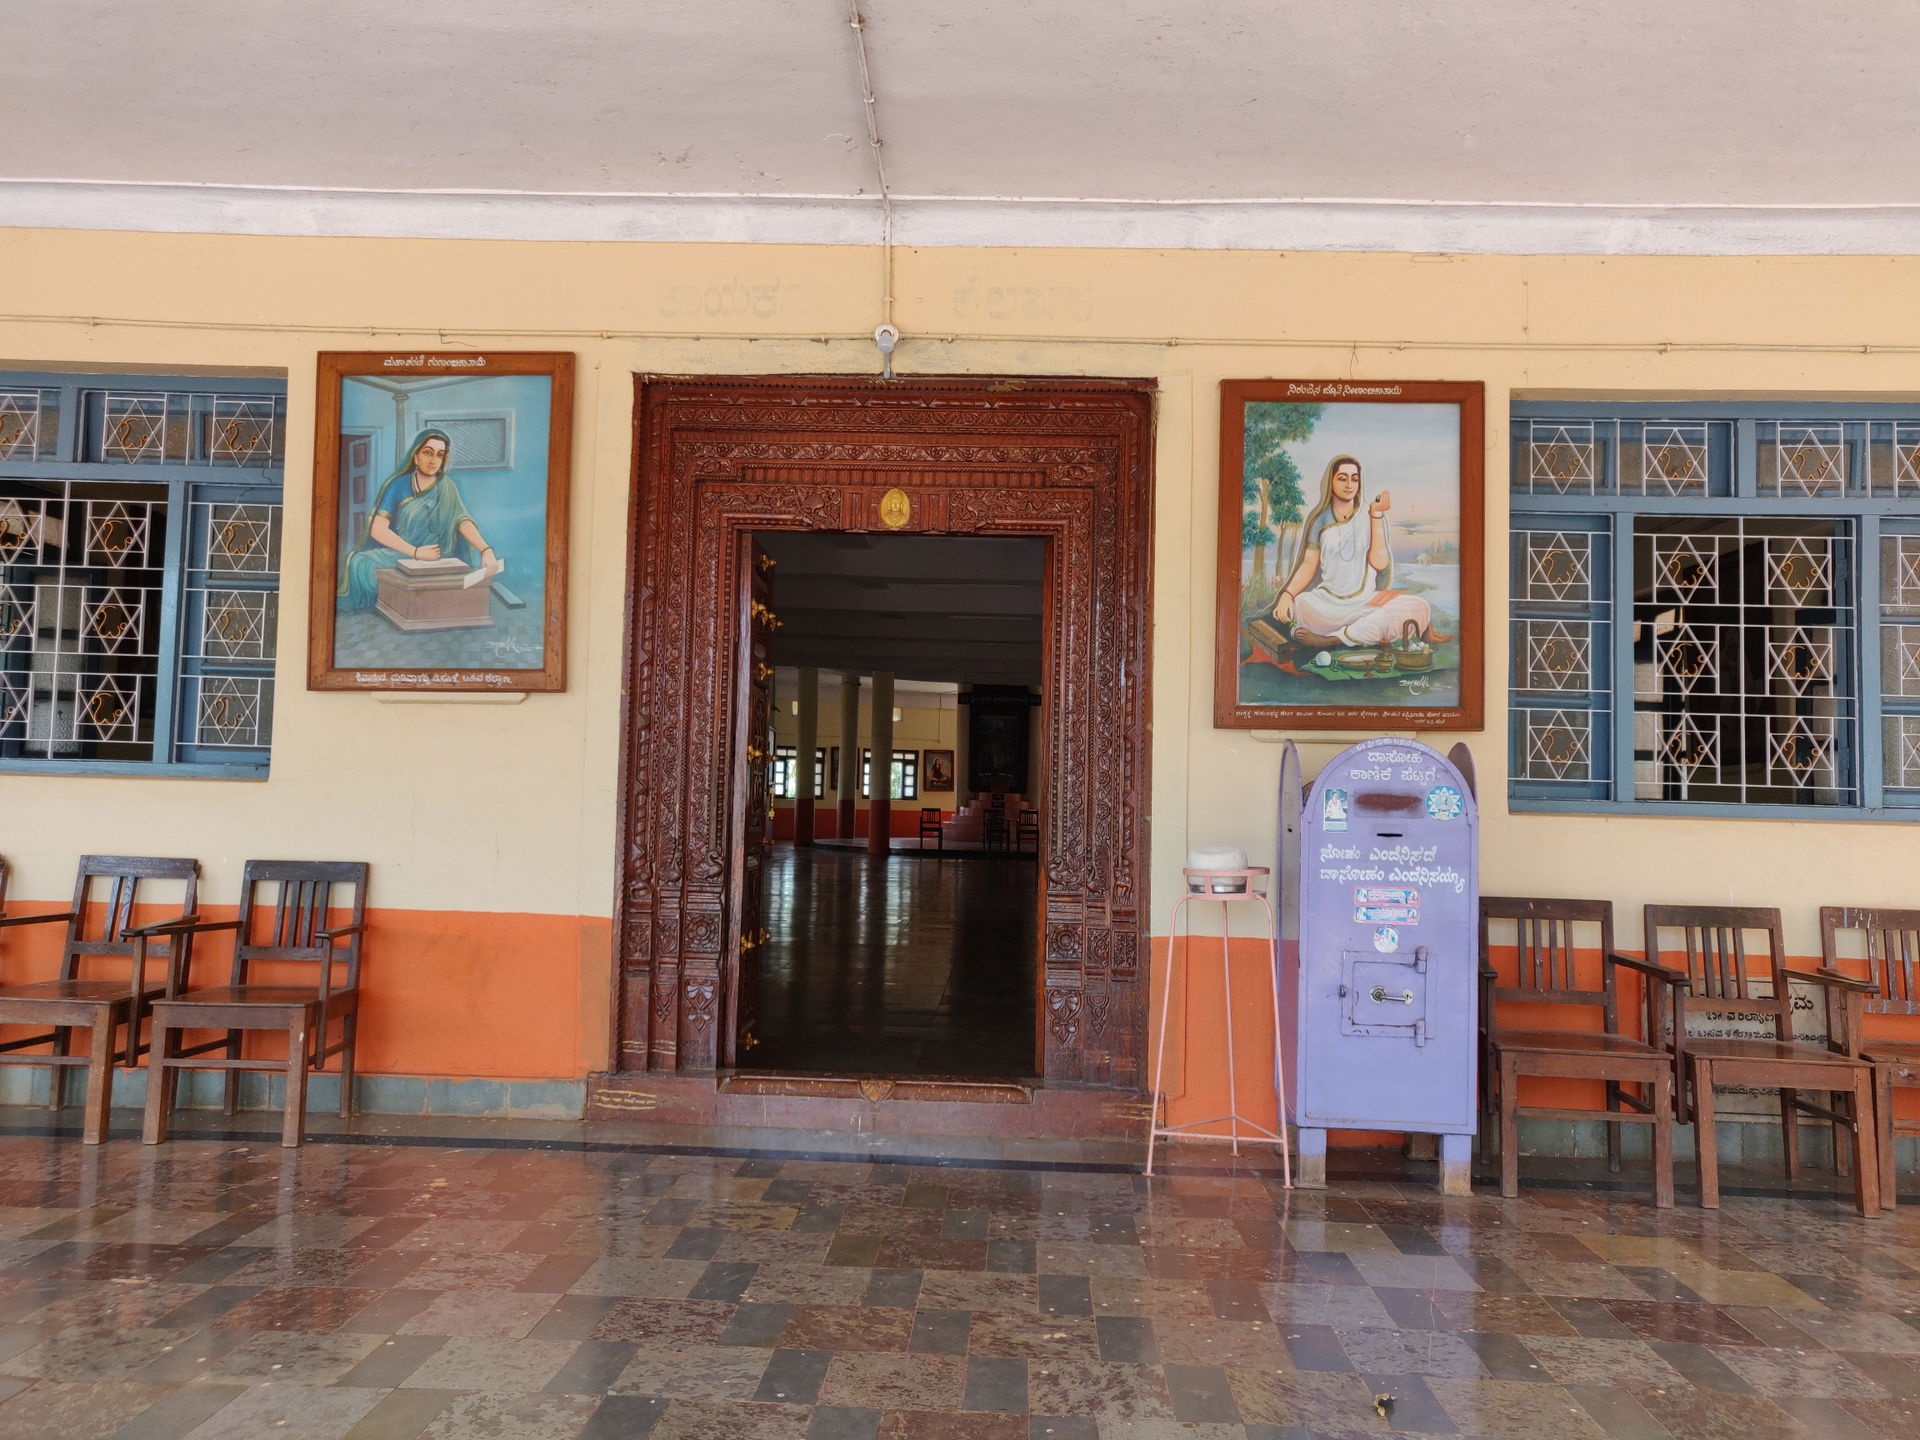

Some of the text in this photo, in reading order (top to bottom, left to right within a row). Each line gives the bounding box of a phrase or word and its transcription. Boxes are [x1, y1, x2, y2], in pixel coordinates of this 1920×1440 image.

[1368, 749, 1423, 764] ದಾಸೋಹ
[1350, 765, 1392, 781] ಕಾಣಿಕೆ
[1320, 843, 1438, 867] ಸೋಹಂ ಎಂದೆನಿಸದೆ
[1320, 864, 1385, 885] ದಾಸೋಹಂ
